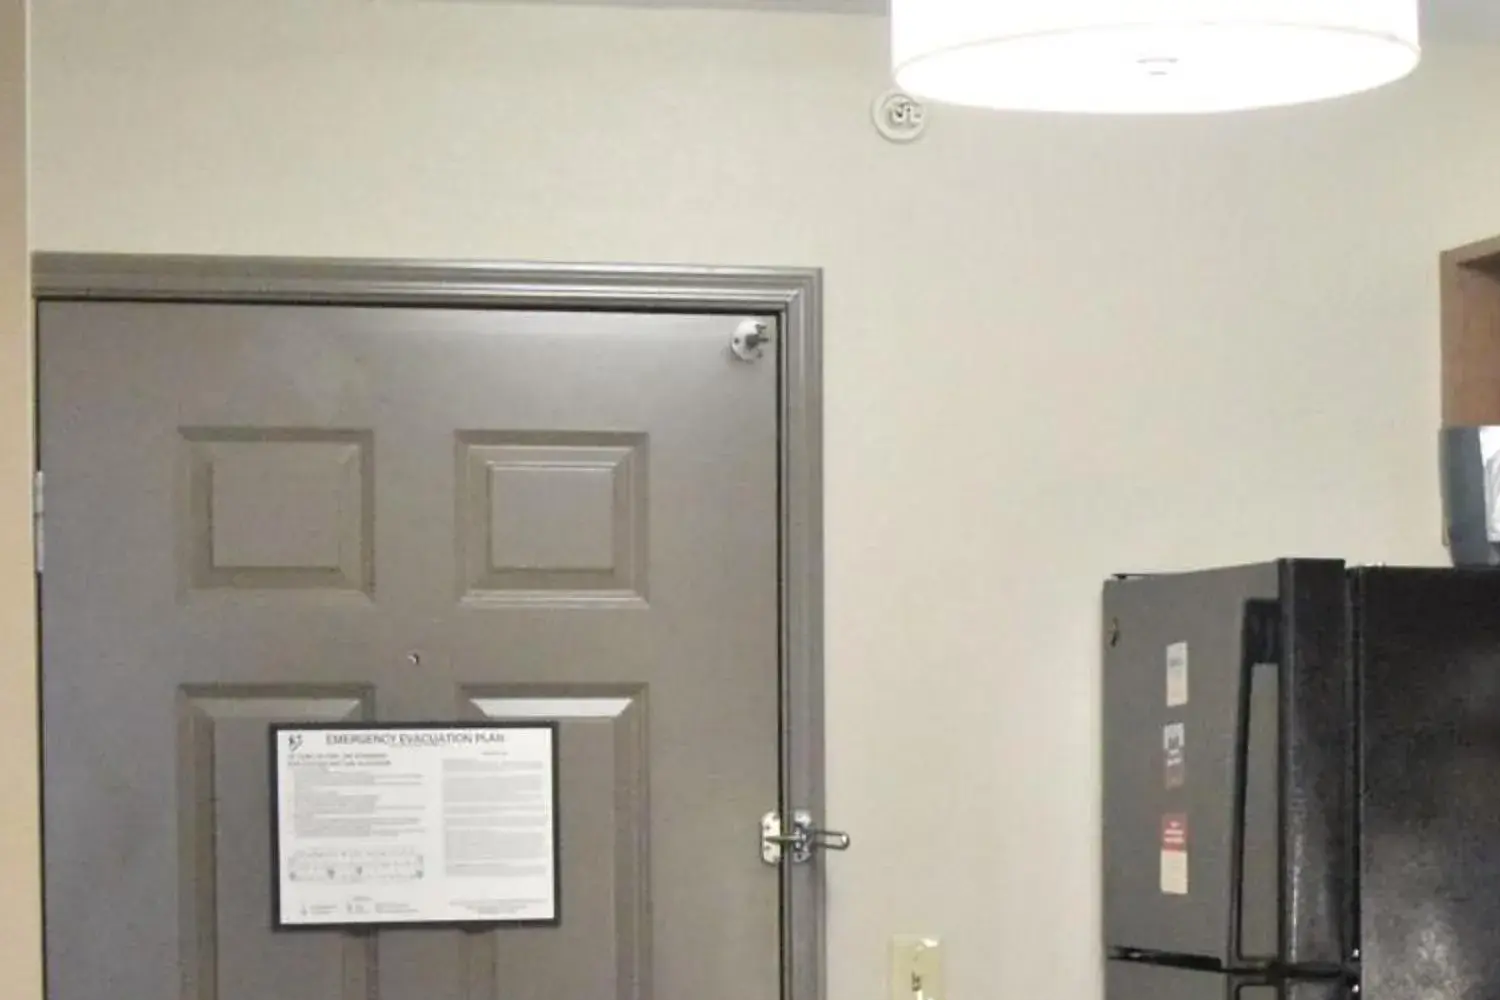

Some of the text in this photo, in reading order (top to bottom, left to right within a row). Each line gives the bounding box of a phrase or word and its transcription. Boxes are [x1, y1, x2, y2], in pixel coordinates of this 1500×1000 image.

[325, 732, 505, 745] EMERGENCY EVACUATION PLAN
